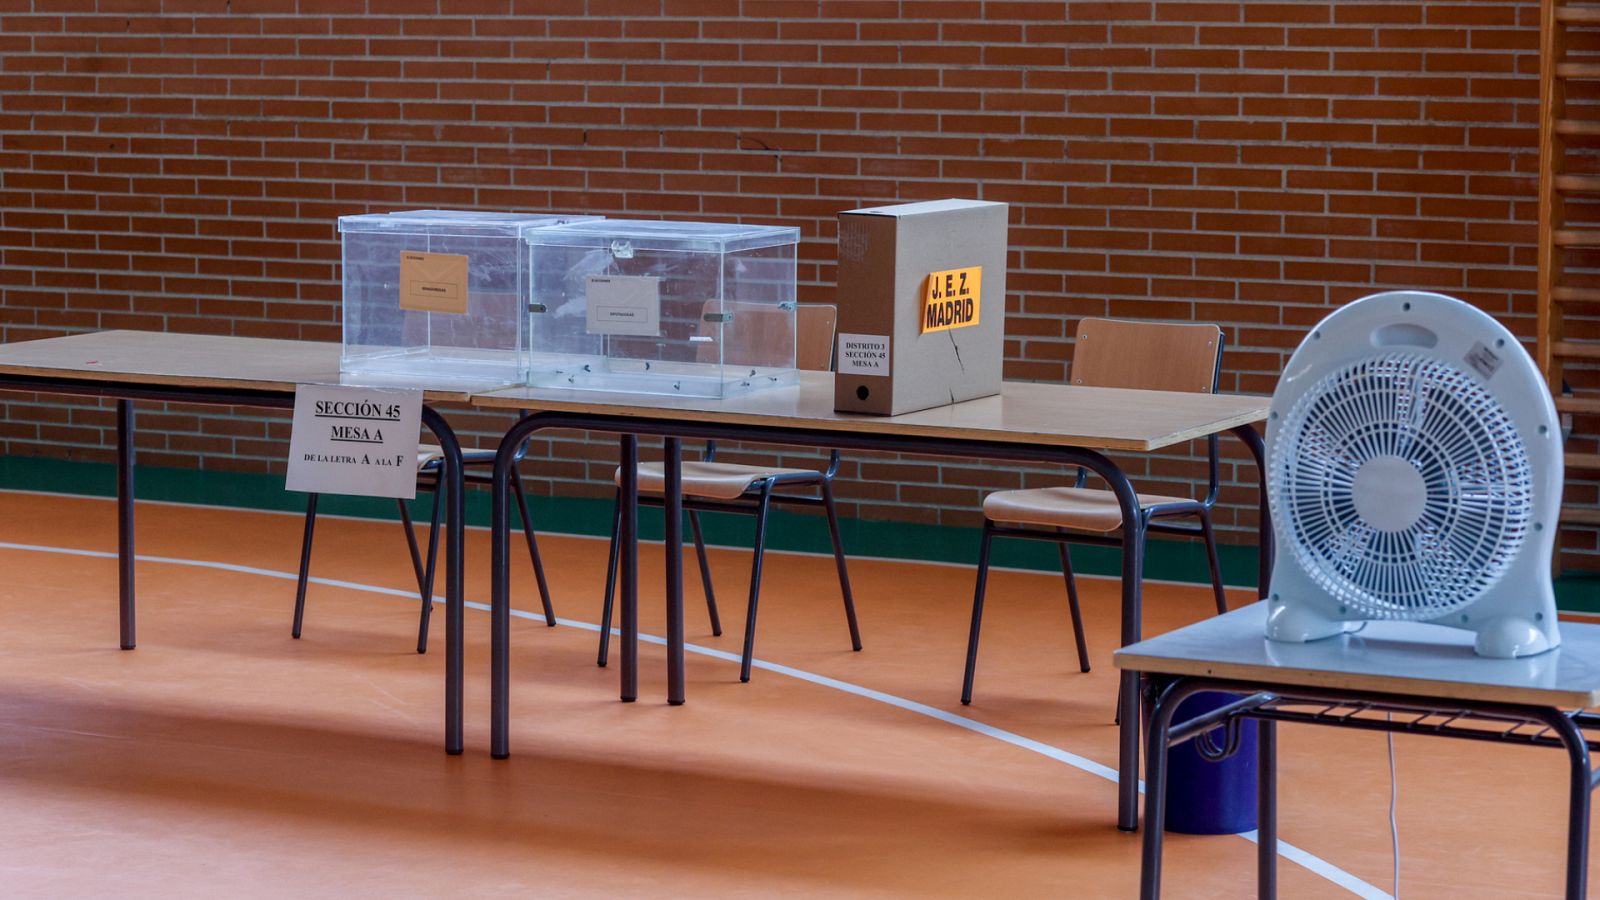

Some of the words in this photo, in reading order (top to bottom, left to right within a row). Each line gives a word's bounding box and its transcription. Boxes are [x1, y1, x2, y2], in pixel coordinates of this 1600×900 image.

[926, 298, 974, 328] MADRID
[846, 342, 880, 350] DISTRITO
[845, 350, 877, 358] SECCIÓN
[316, 400, 381, 416] SECCIÓN
[386, 405, 400, 418] 45
[331, 426, 370, 440] MESA
[374, 429, 383, 440] A
[330, 456, 356, 464] LETRA
[361, 454, 370, 464] A
[382, 458, 392, 466] LA
[396, 456, 404, 466] F
